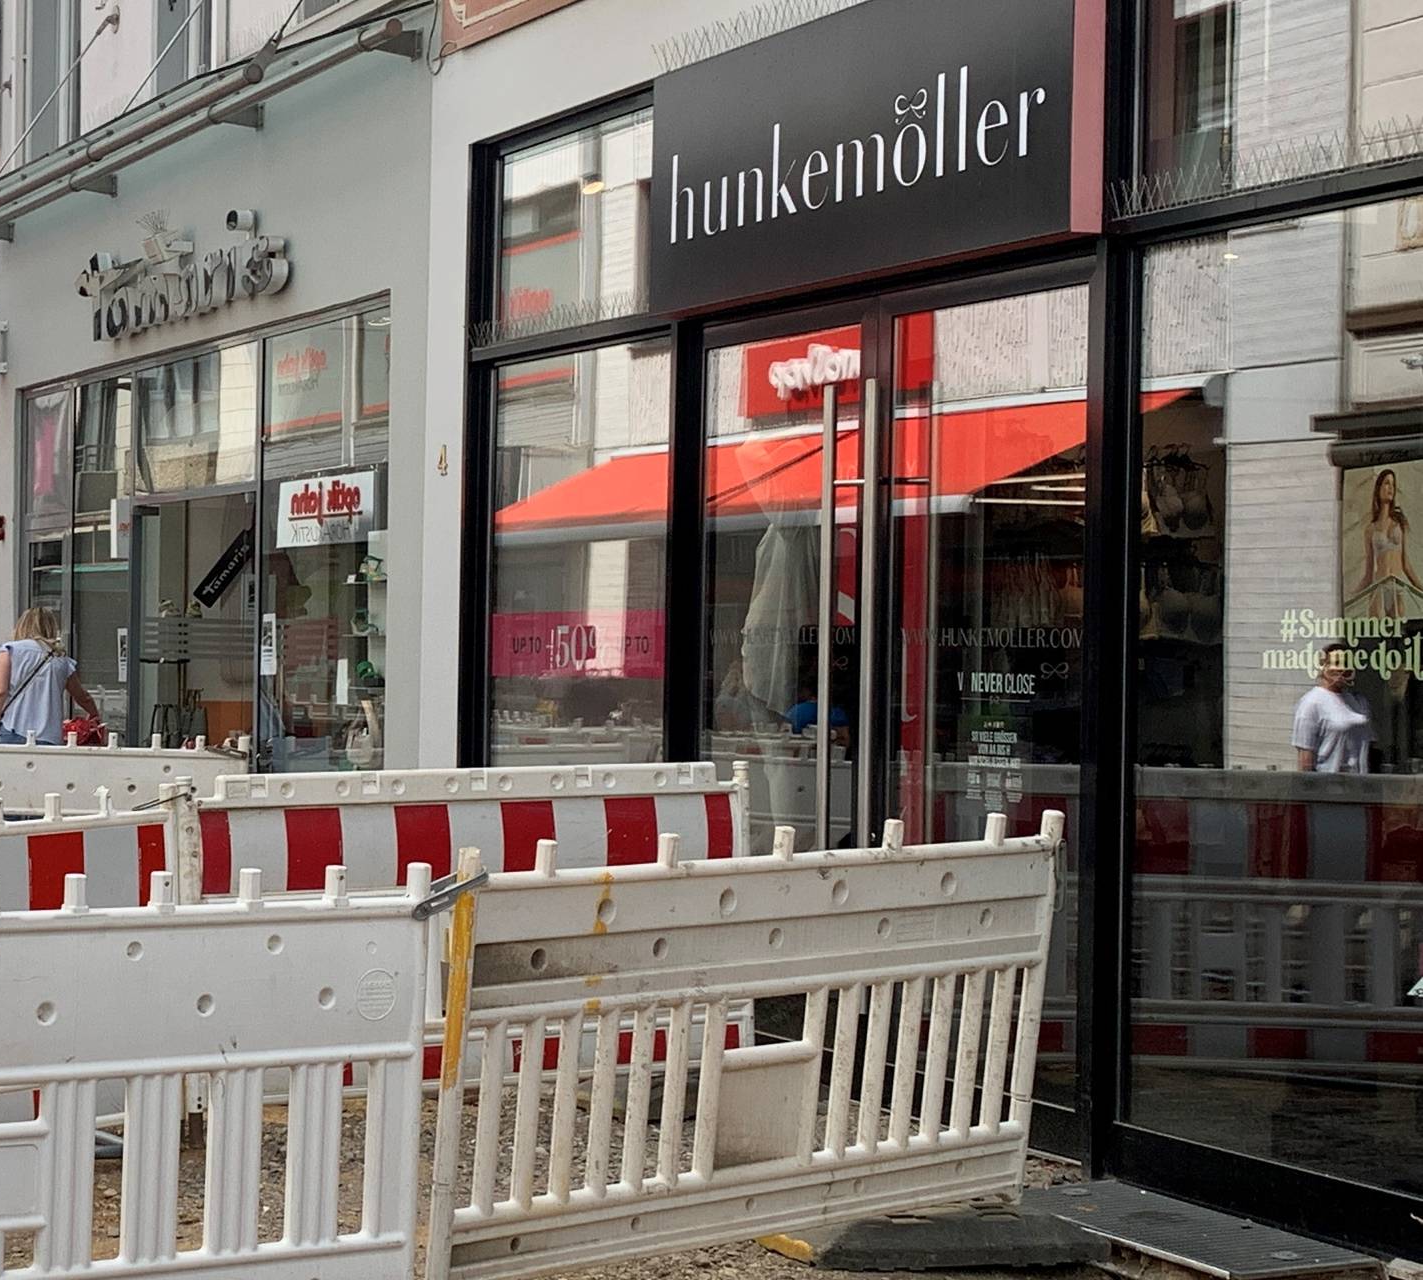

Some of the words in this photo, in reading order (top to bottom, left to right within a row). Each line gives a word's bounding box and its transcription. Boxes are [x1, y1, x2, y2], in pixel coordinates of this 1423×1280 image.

[437, 444, 449, 476] 4
[1280, 608, 1408, 648] #Summer
[528, 636, 542, 654] TO
[1262, 640, 1326, 680] made
[1328, 647, 1369, 671] me
[1369, 640, 1403, 681] do
[971, 671, 1003, 693] NEVER
[1004, 672, 1036, 695] CLOSE
